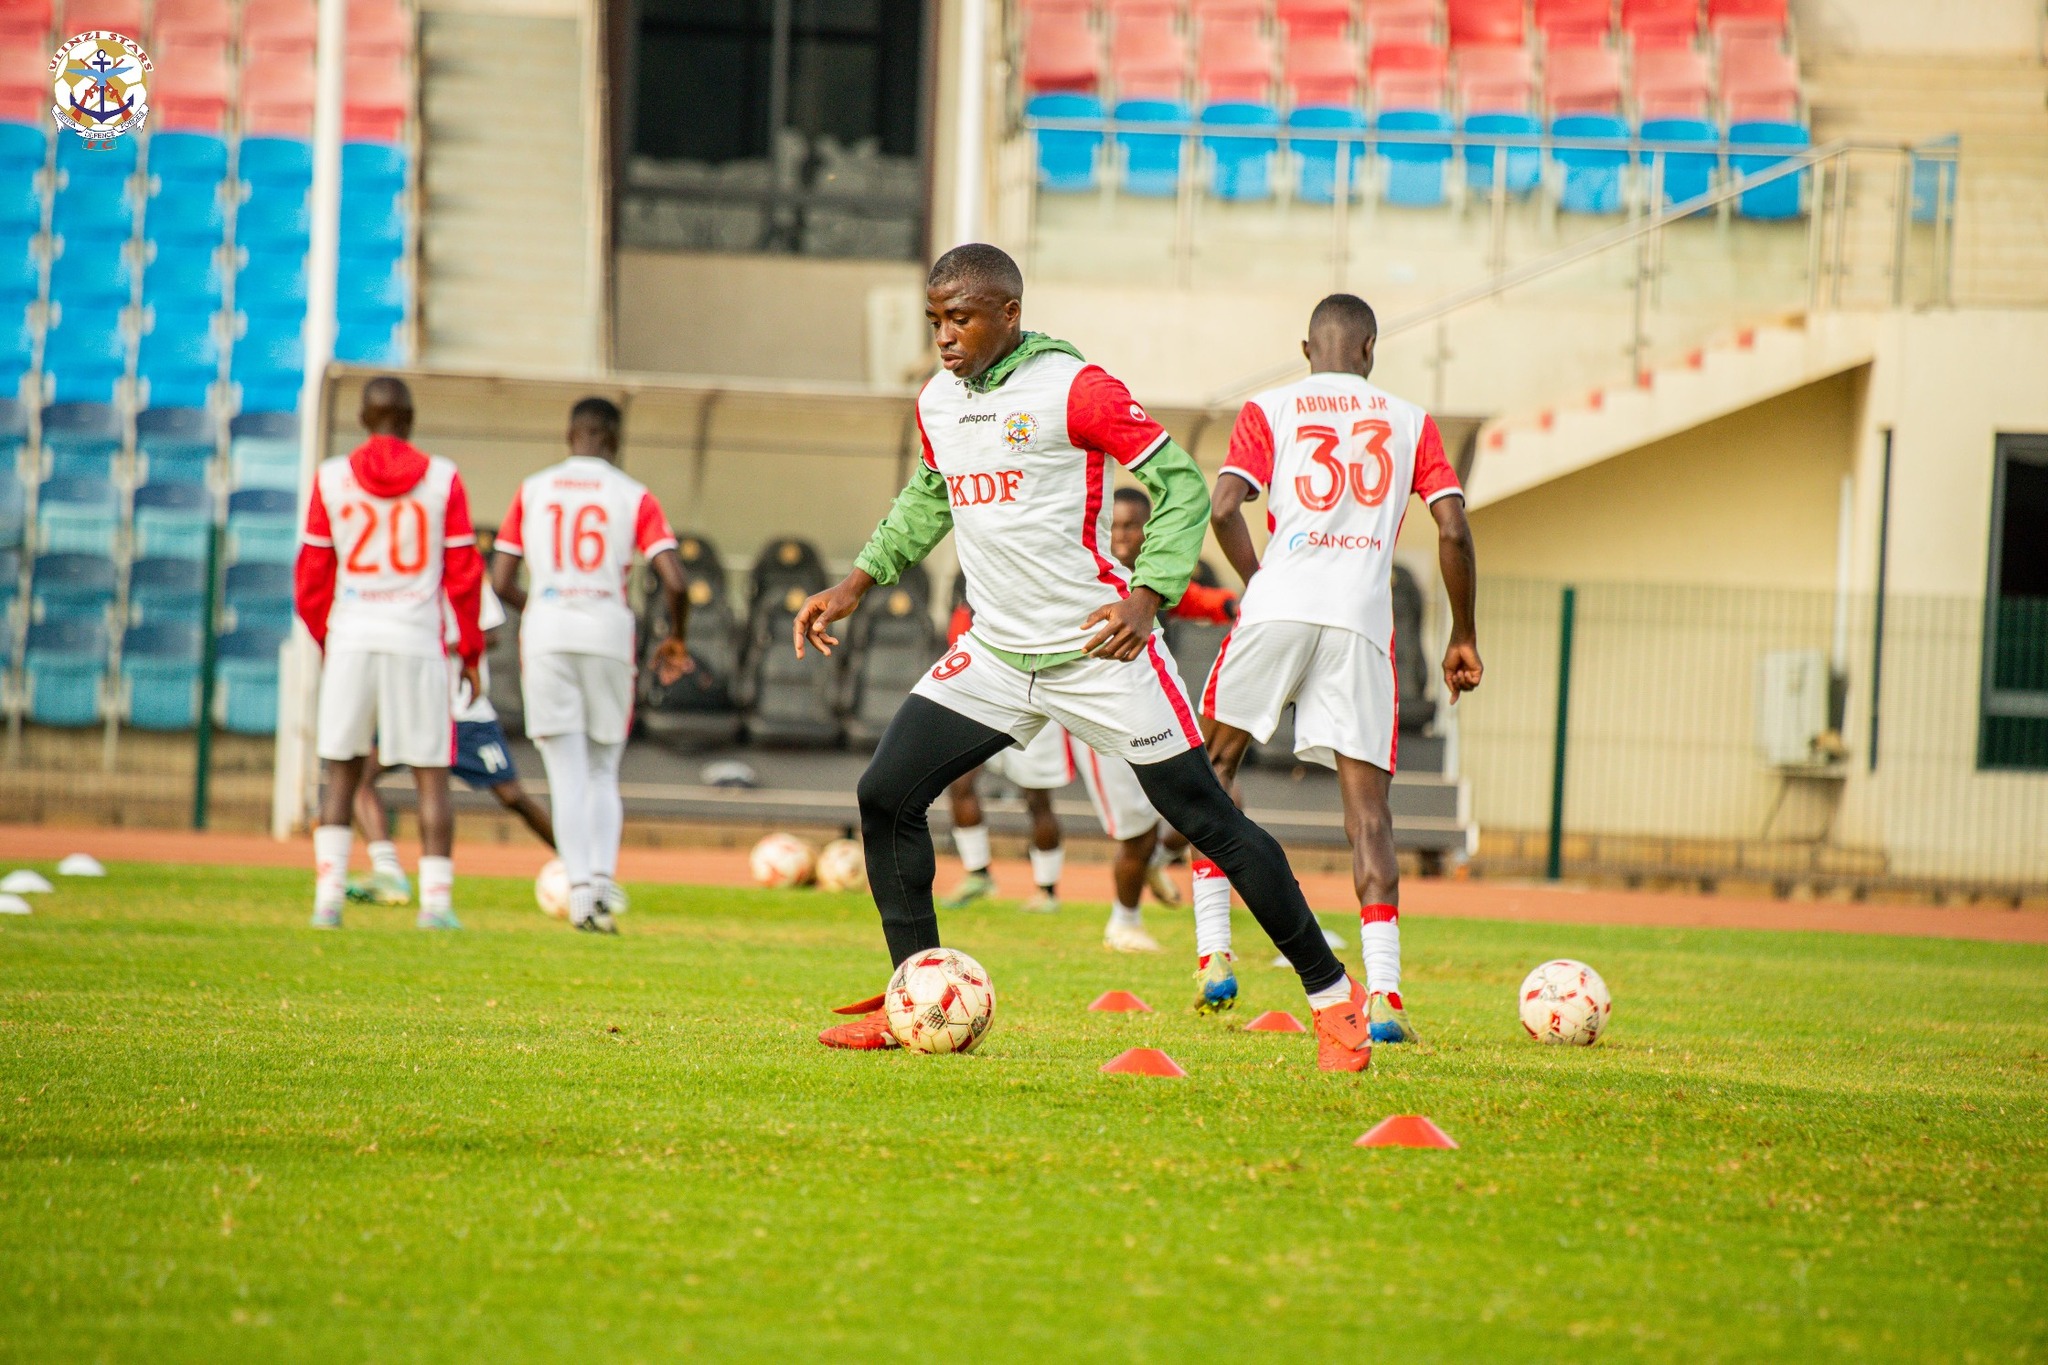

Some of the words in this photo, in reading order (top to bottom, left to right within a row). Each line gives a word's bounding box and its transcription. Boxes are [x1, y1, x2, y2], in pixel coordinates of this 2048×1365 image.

[958, 413, 997, 424] uhlsport
[1296, 395, 1361, 414] ABONGA
[1368, 396, 1388, 410] JR
[1295, 419, 1393, 512] 33
[947, 470, 1024, 507] KDF
[340, 500, 429, 574] 20
[546, 503, 608, 573] 16
[1308, 531, 1381, 551] SANCOM
[1130, 728, 1173, 748] uhlsport
